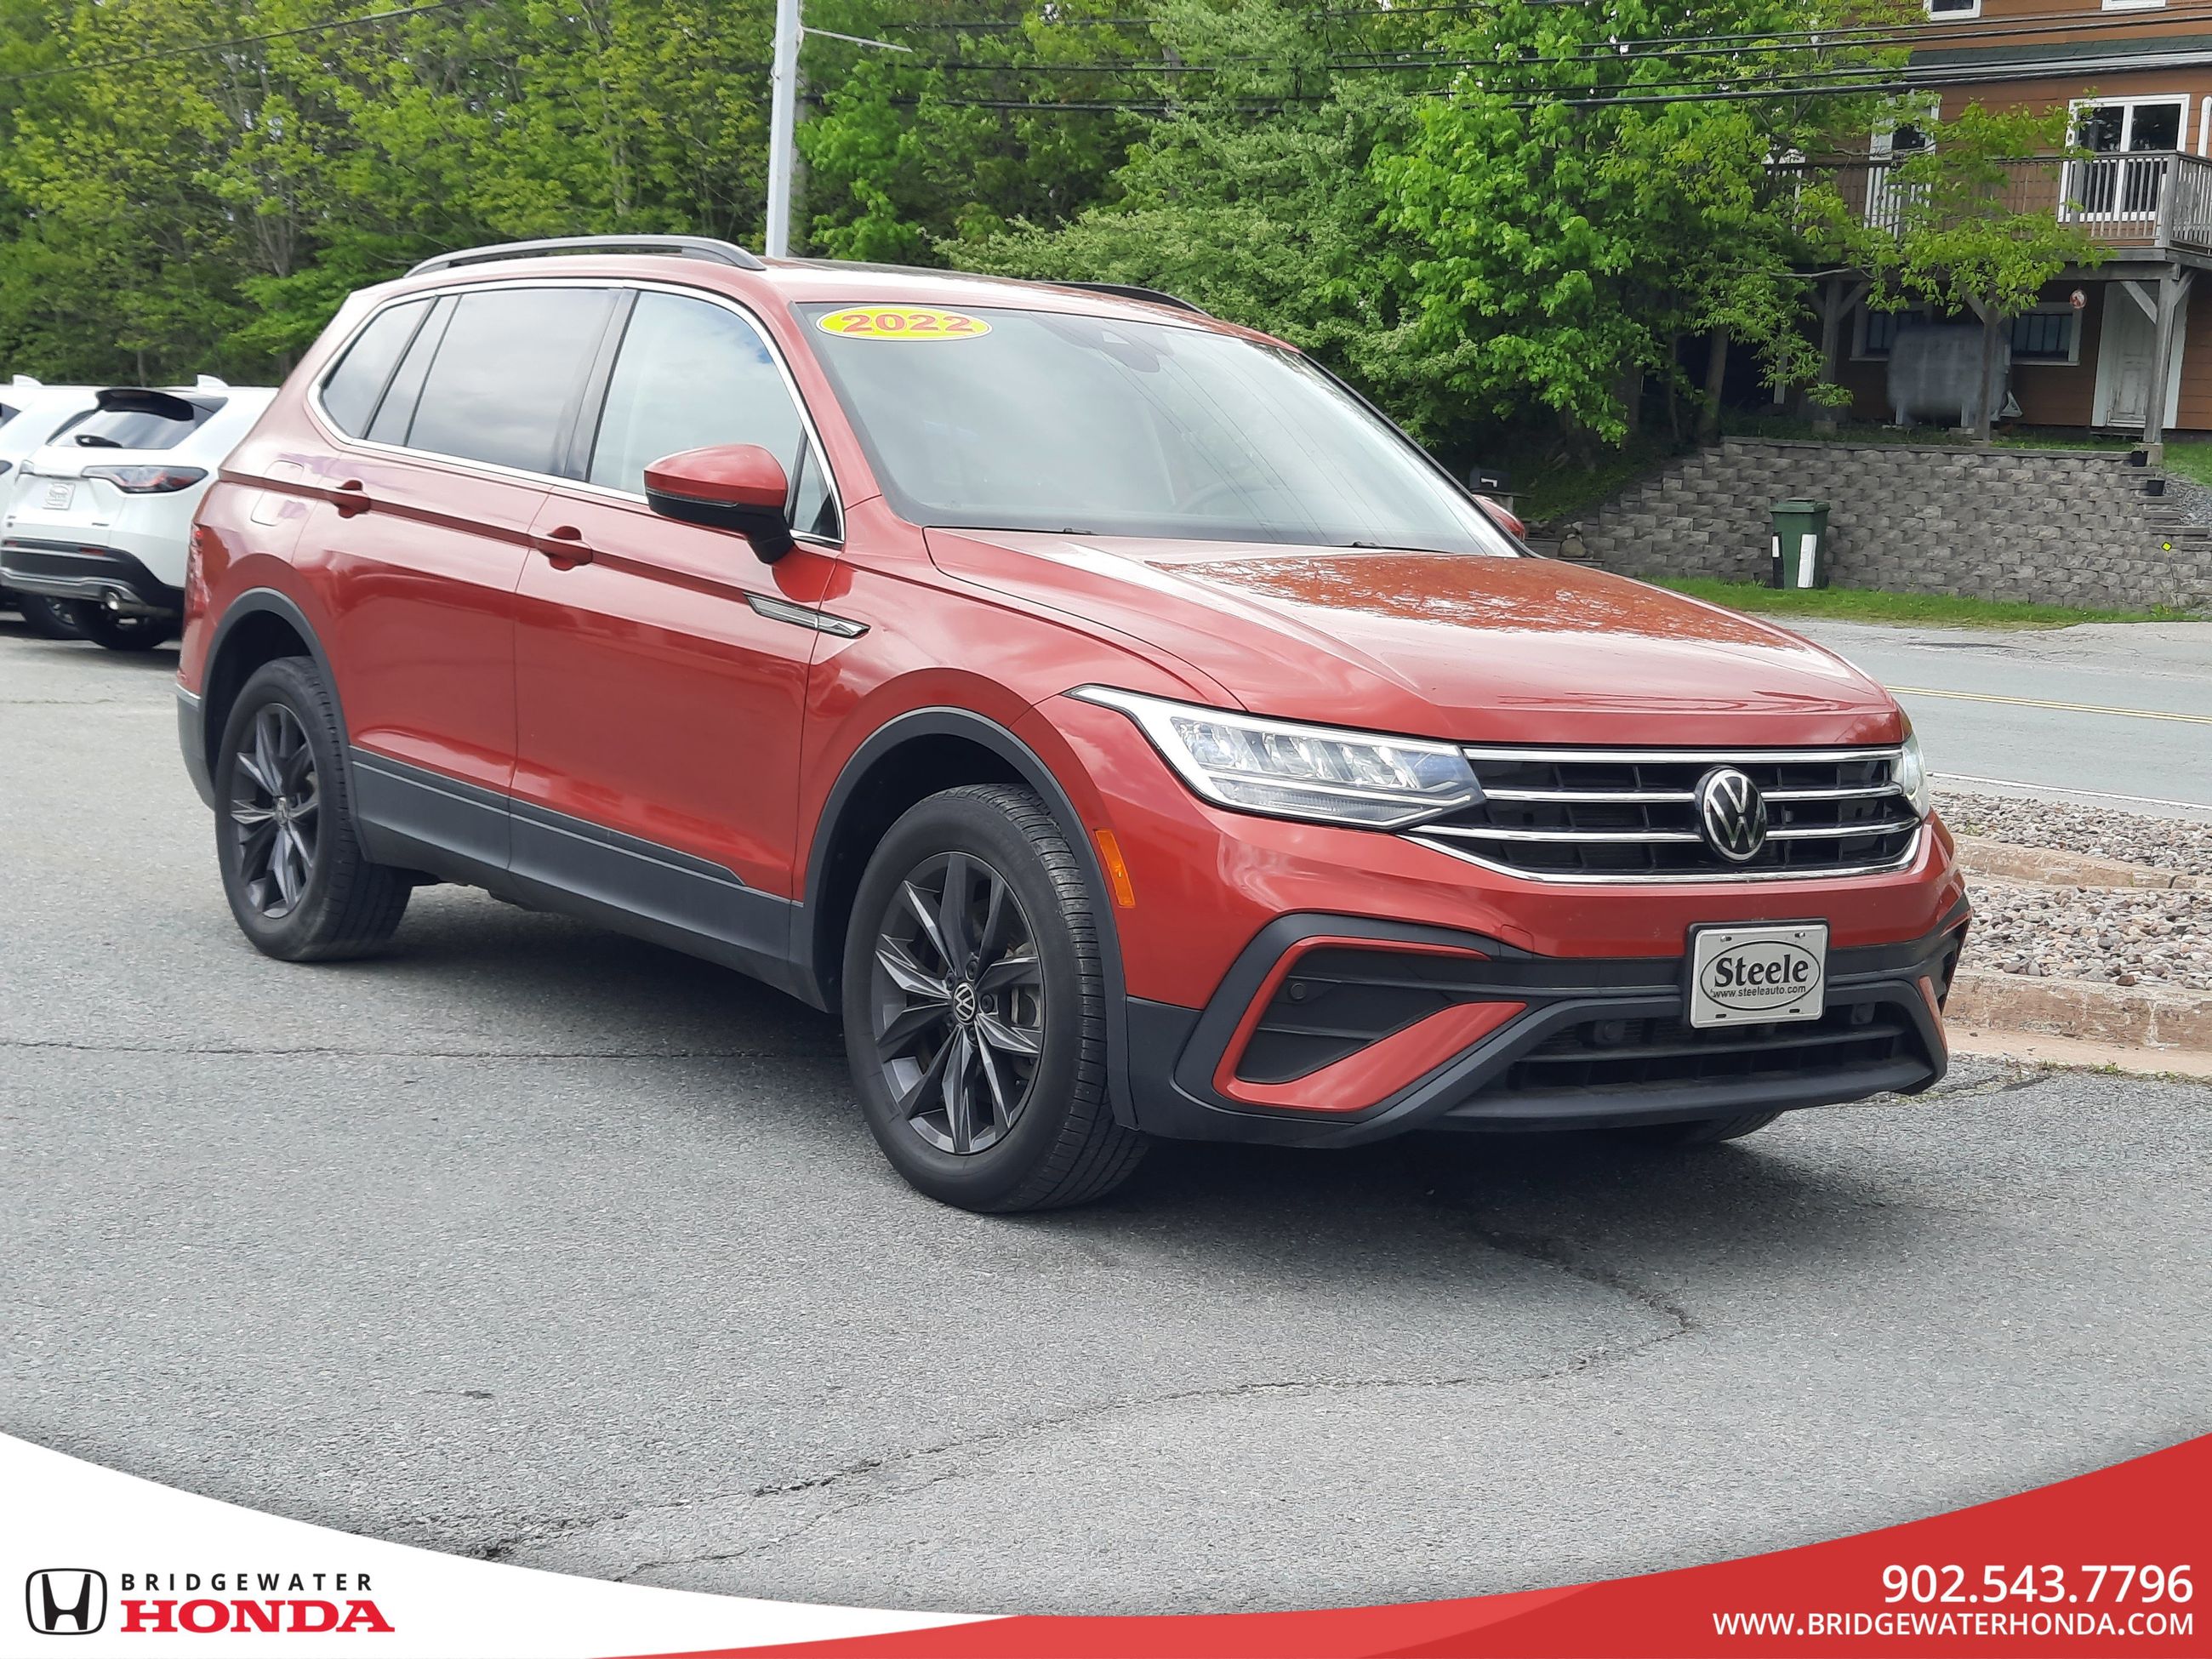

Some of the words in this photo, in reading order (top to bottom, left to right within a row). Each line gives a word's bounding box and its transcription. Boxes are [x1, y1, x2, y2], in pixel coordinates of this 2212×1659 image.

[841, 314, 976, 333] 2022
[1713, 954, 1810, 988] Steele
[1711, 985, 1806, 998] www.steeleauto.com
